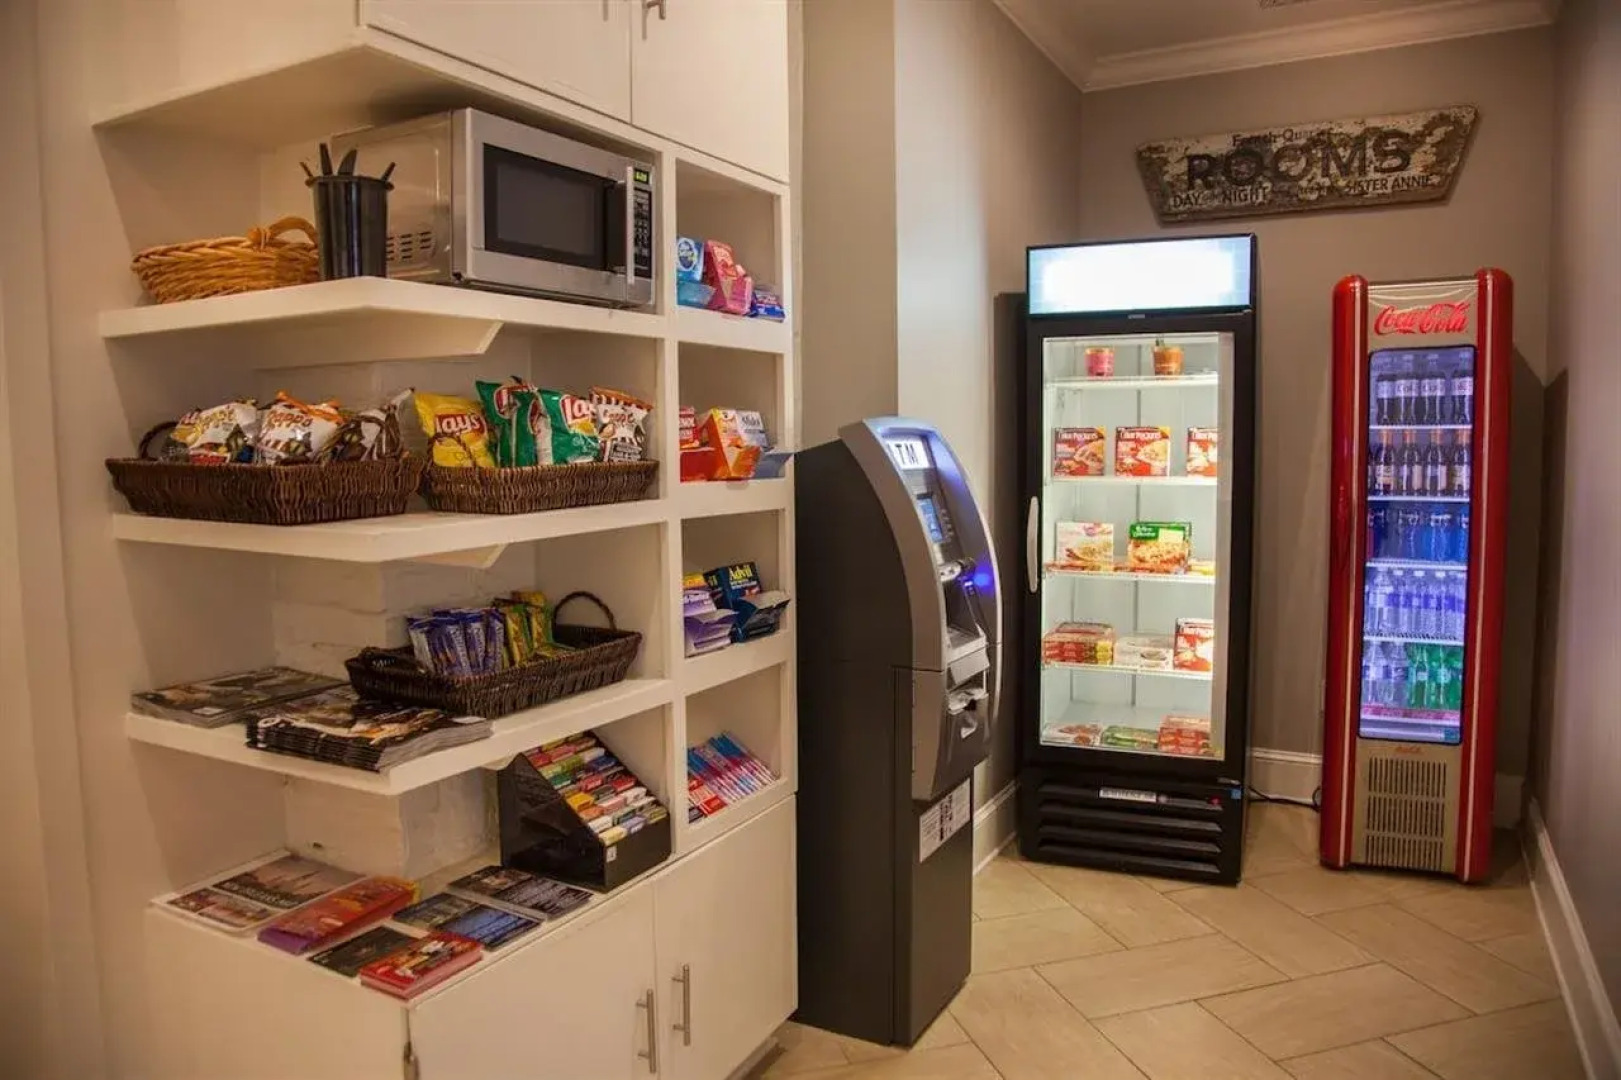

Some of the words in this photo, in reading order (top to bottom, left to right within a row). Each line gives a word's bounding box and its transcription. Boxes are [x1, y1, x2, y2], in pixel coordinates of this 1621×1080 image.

[1185, 127, 1412, 192] ROOMS
[1172, 189, 1202, 209] DAY
[1220, 185, 1269, 205] NIGHT
